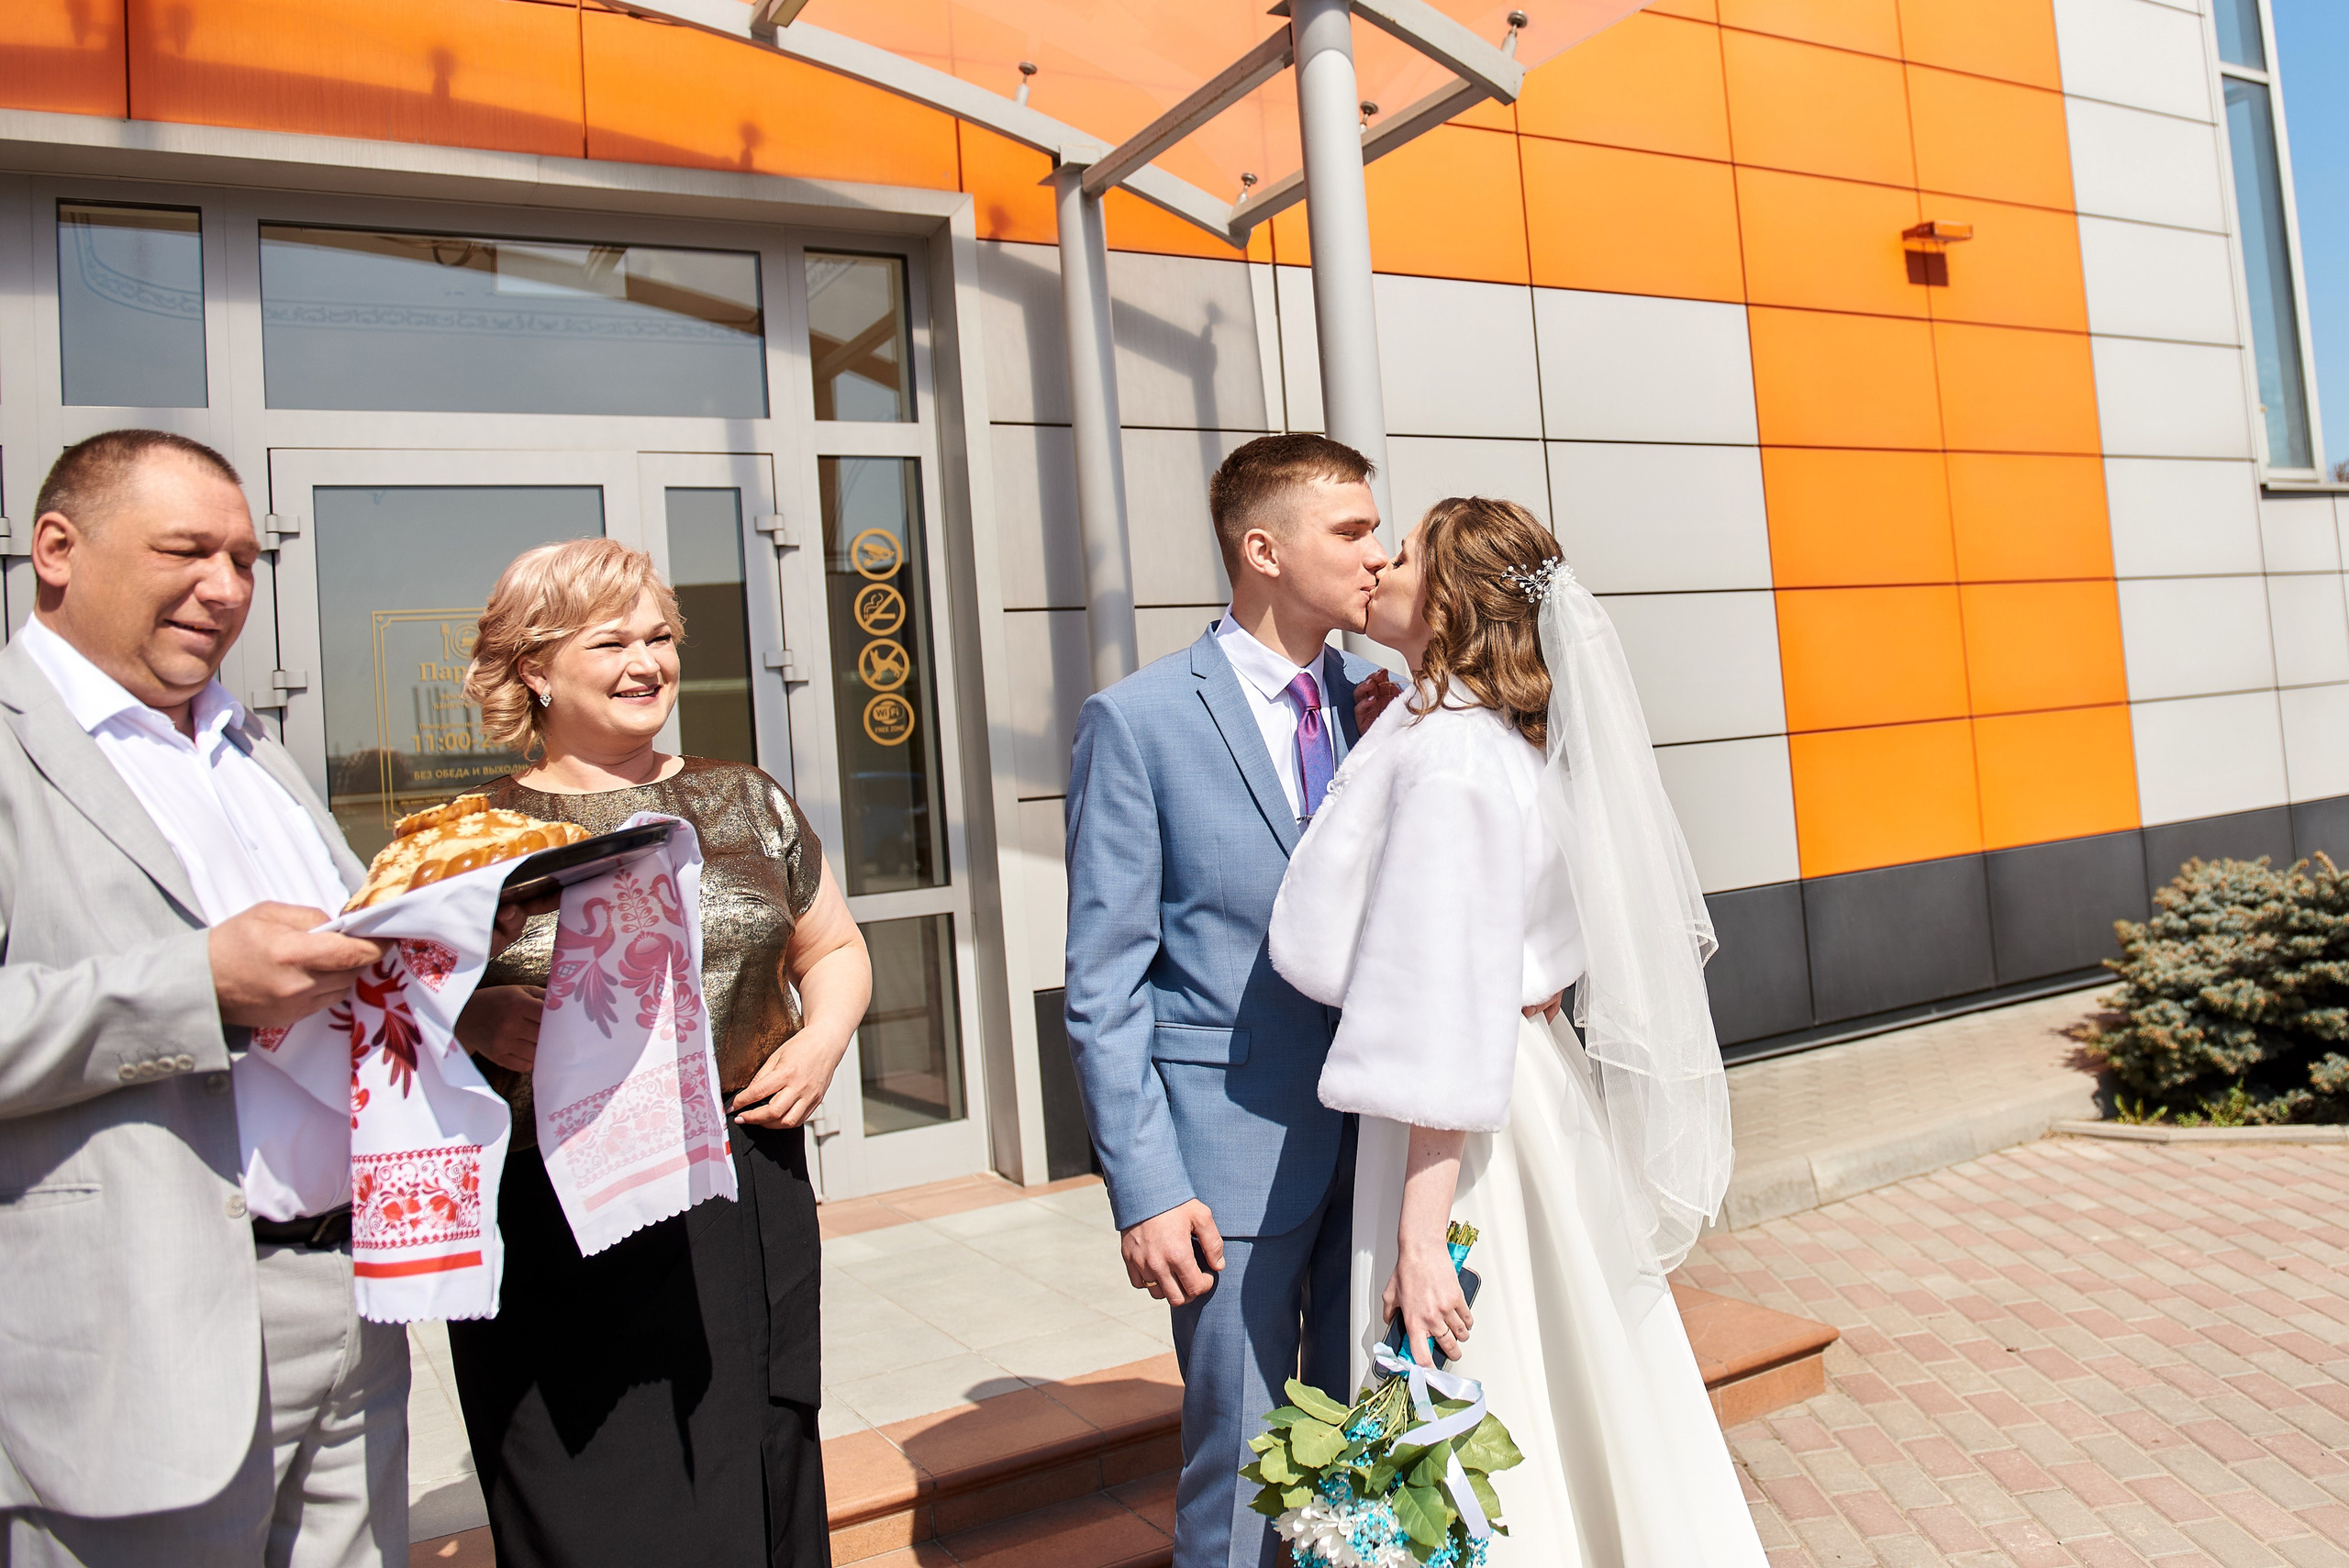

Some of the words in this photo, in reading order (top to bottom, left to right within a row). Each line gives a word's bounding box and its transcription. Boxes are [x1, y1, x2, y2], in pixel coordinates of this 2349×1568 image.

[419, 662, 466, 684] Пар
[874, 726, 889, 734] FREE
[411, 731, 502, 753] 11:00-2
[414, 770, 432, 781] БЕЗ
[435, 768, 470, 780] ОБЕДА
[472, 768, 480, 777] И
